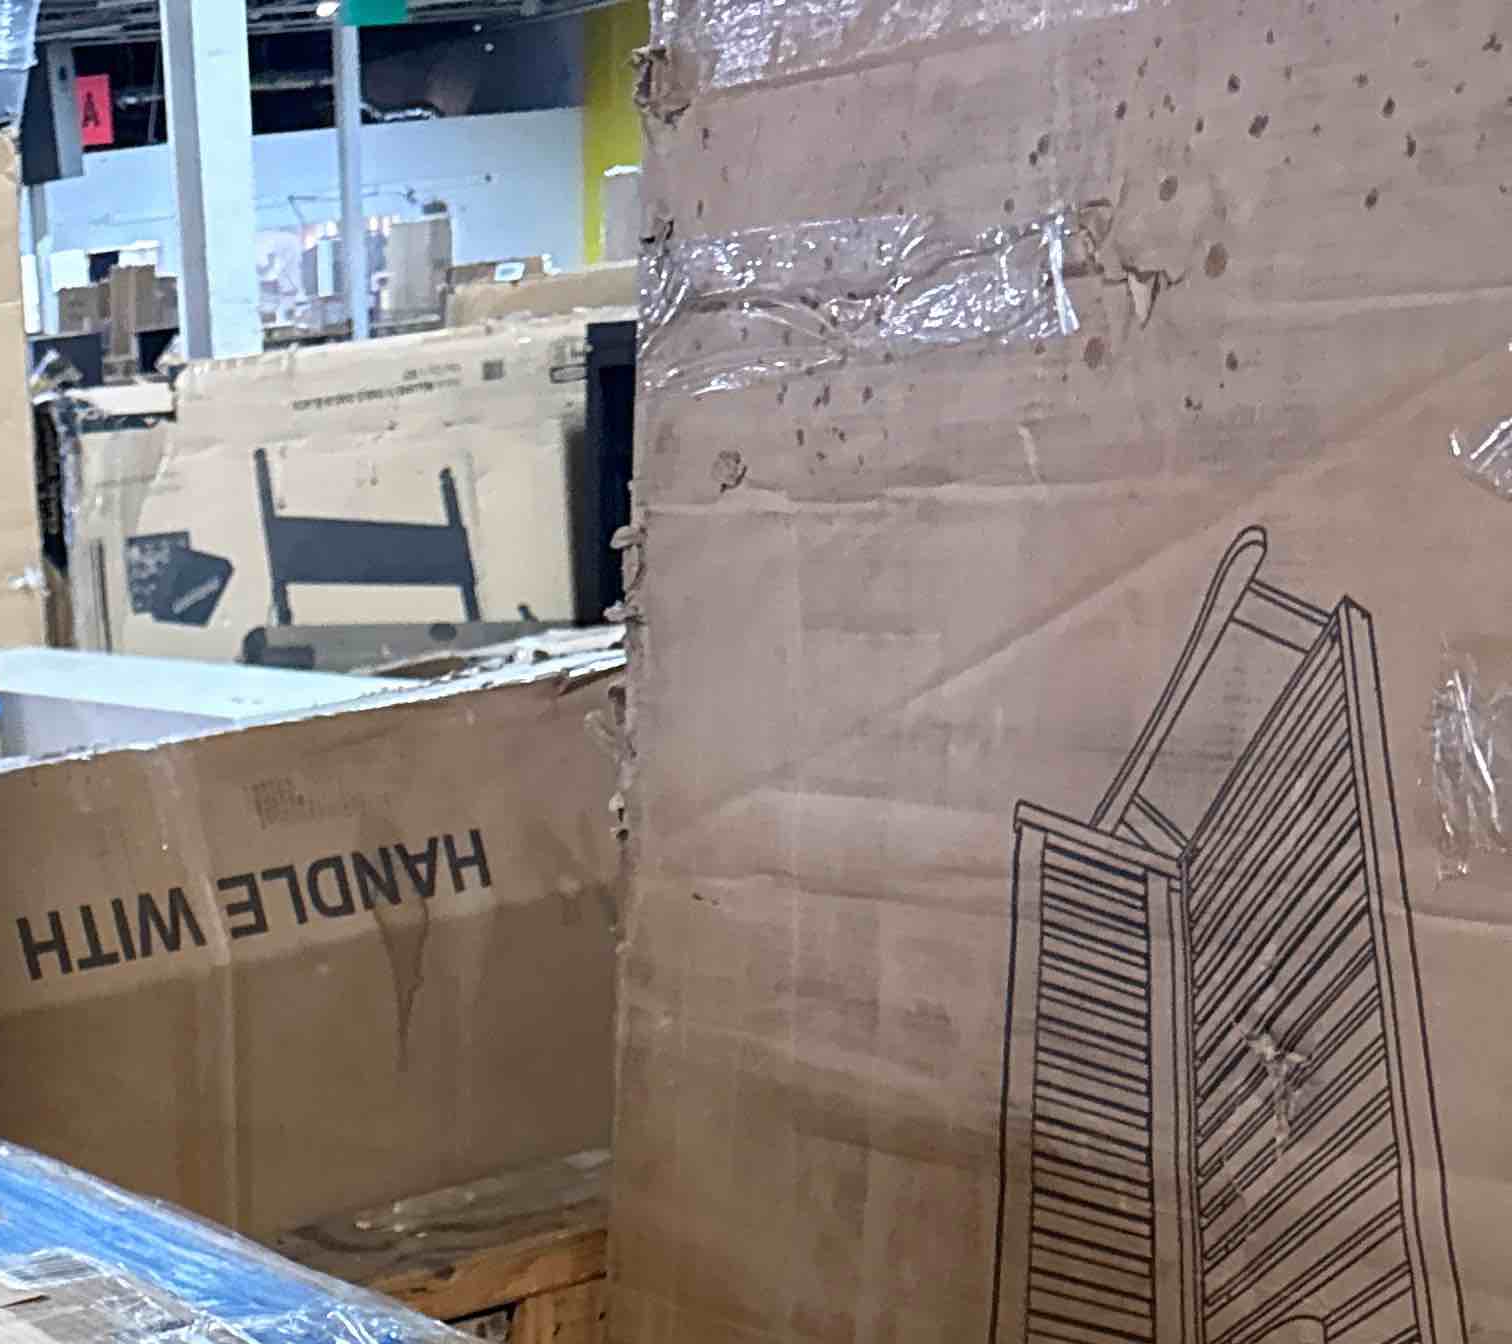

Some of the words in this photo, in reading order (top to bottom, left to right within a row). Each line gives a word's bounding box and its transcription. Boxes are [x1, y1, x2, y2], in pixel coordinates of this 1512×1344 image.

[82, 92, 100, 128] A
[216, 828, 492, 939] HANDLE
[15, 885, 206, 980] WITH
